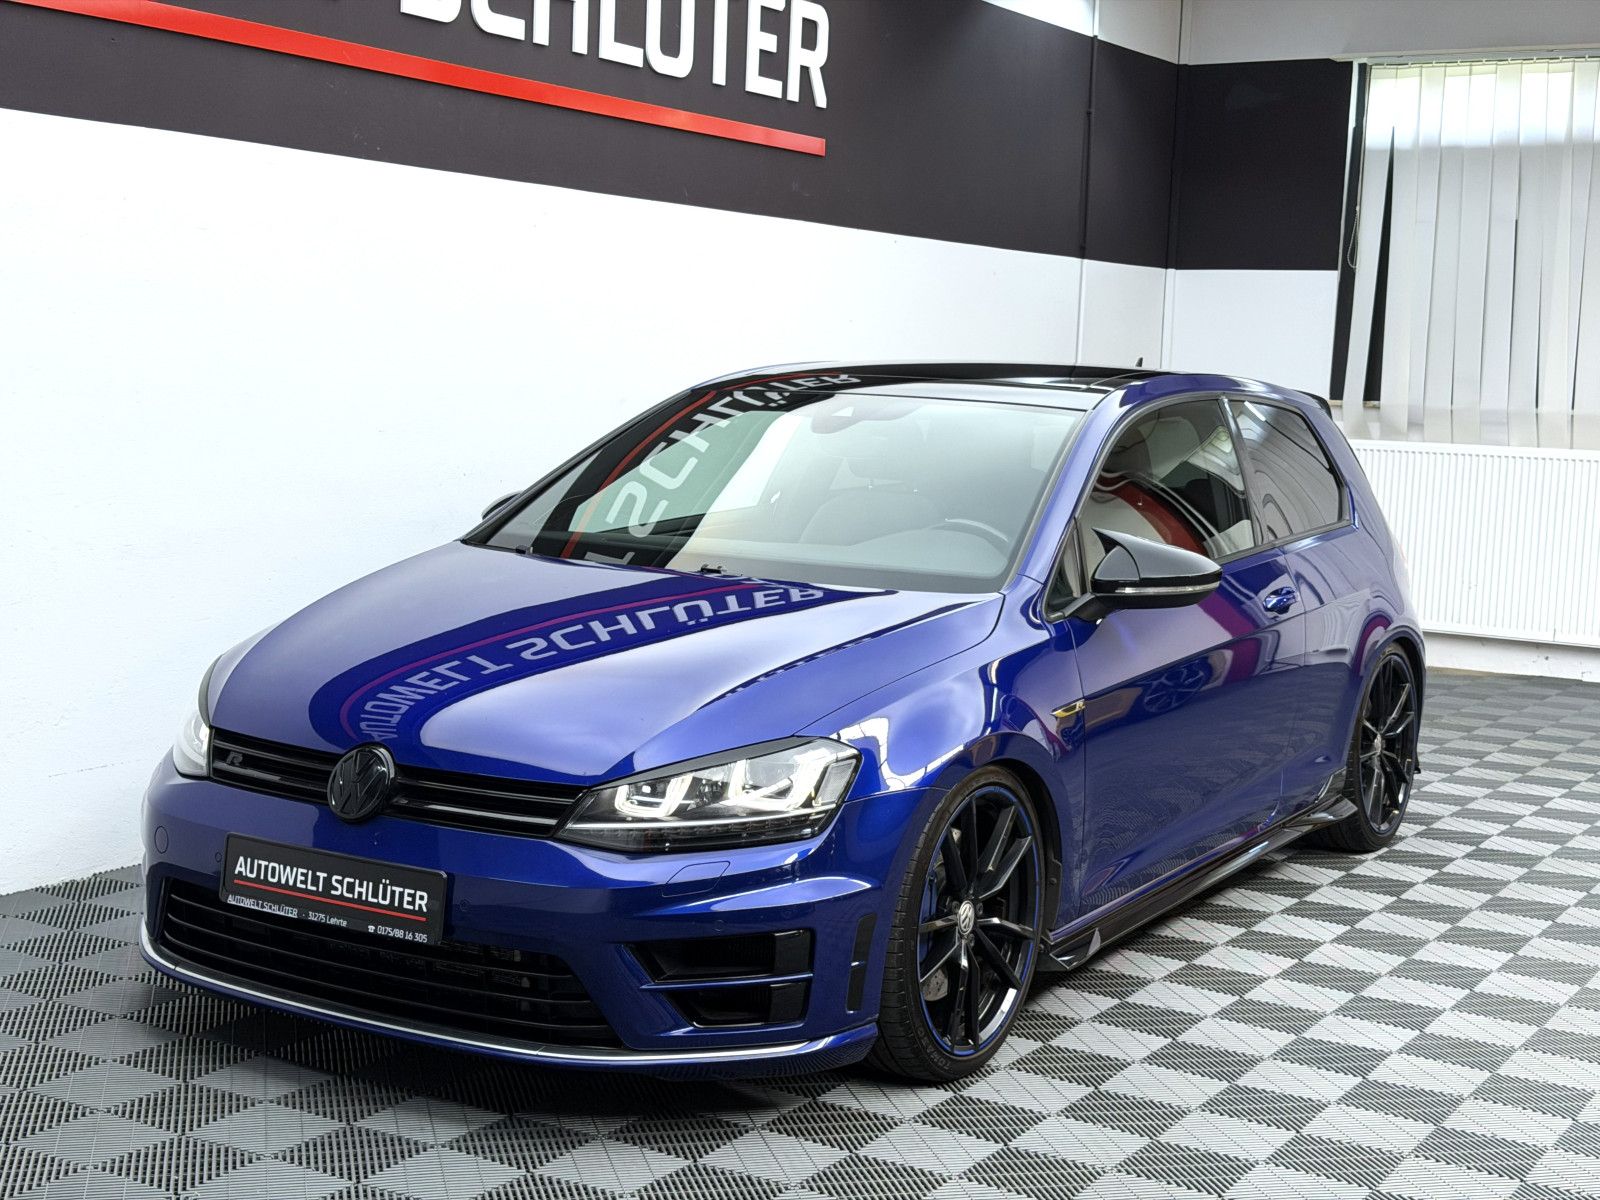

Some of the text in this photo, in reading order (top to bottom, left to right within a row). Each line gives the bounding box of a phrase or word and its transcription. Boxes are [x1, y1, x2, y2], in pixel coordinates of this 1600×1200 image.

[226, 751, 243, 767] R
[234, 855, 428, 913] AUTOWELT SCHLÜTER
[227, 894, 428, 943] AUTOWELT SCHLÜTER 31275 Lehrte 0175/88 16 305
